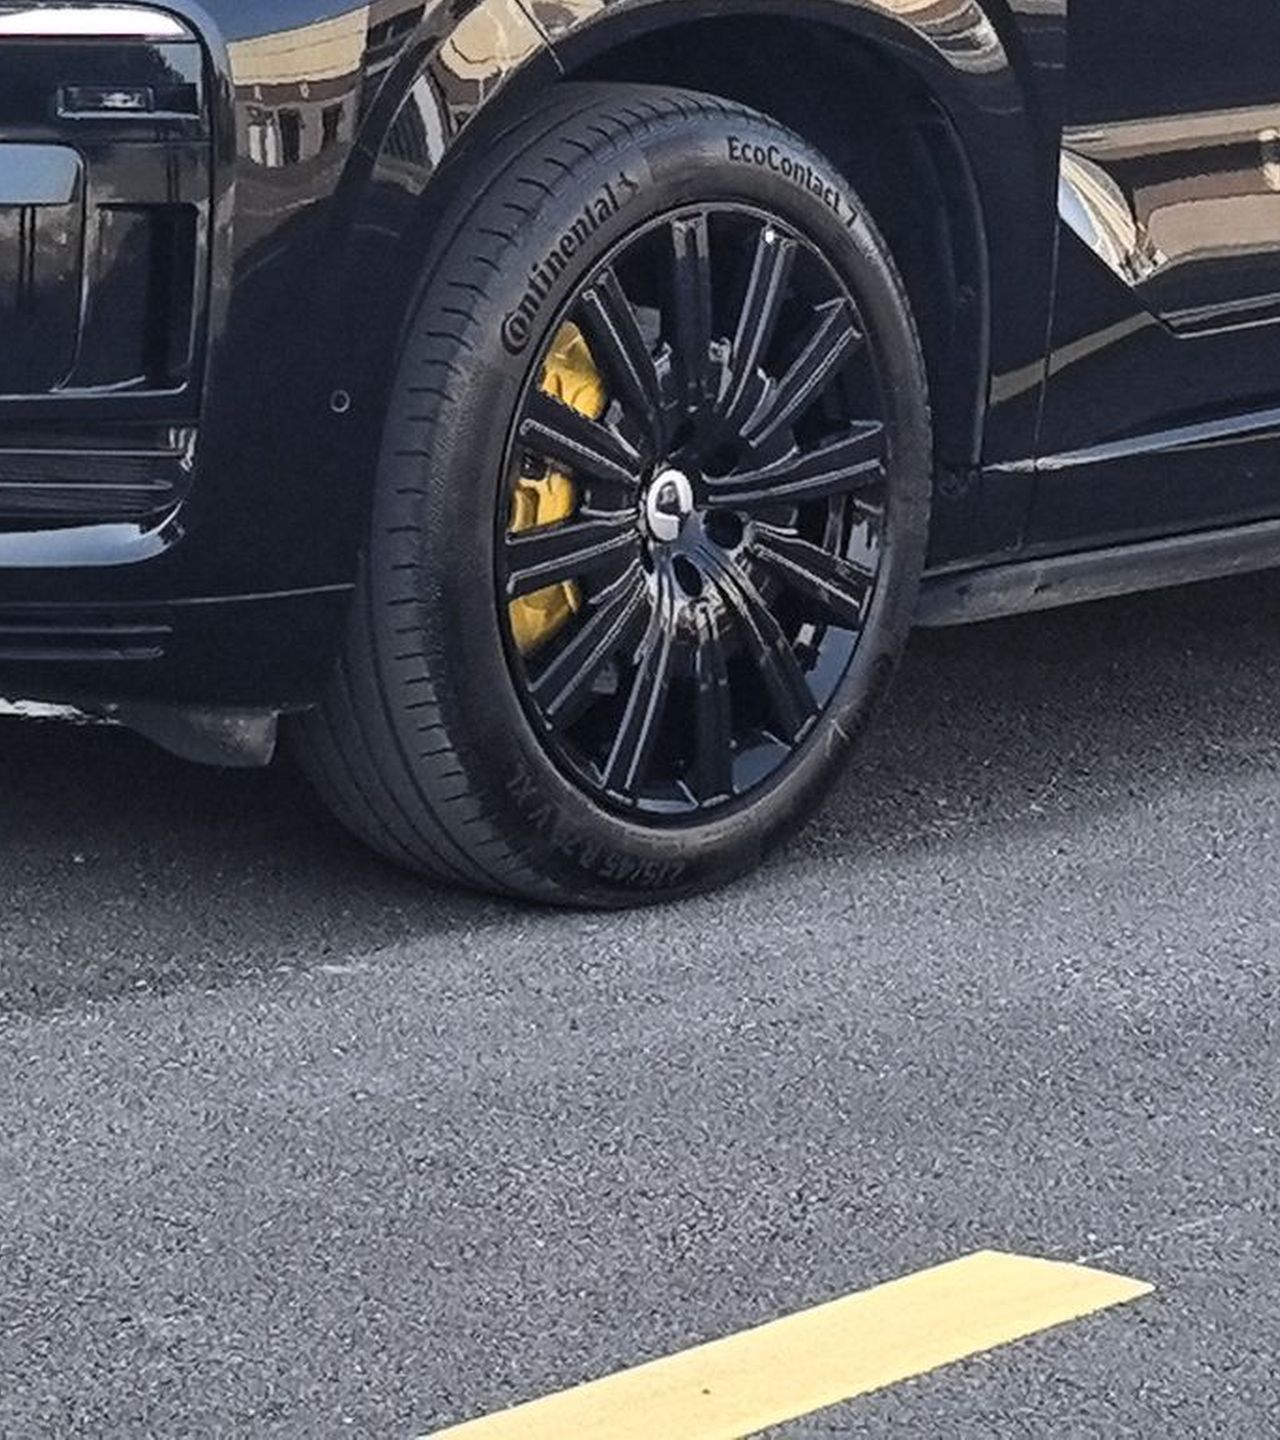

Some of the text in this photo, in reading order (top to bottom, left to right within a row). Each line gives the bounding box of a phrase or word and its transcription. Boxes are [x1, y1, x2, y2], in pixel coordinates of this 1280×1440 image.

[727, 135, 858, 229] EcoContact 7
[500, 182, 621, 356] Continental
